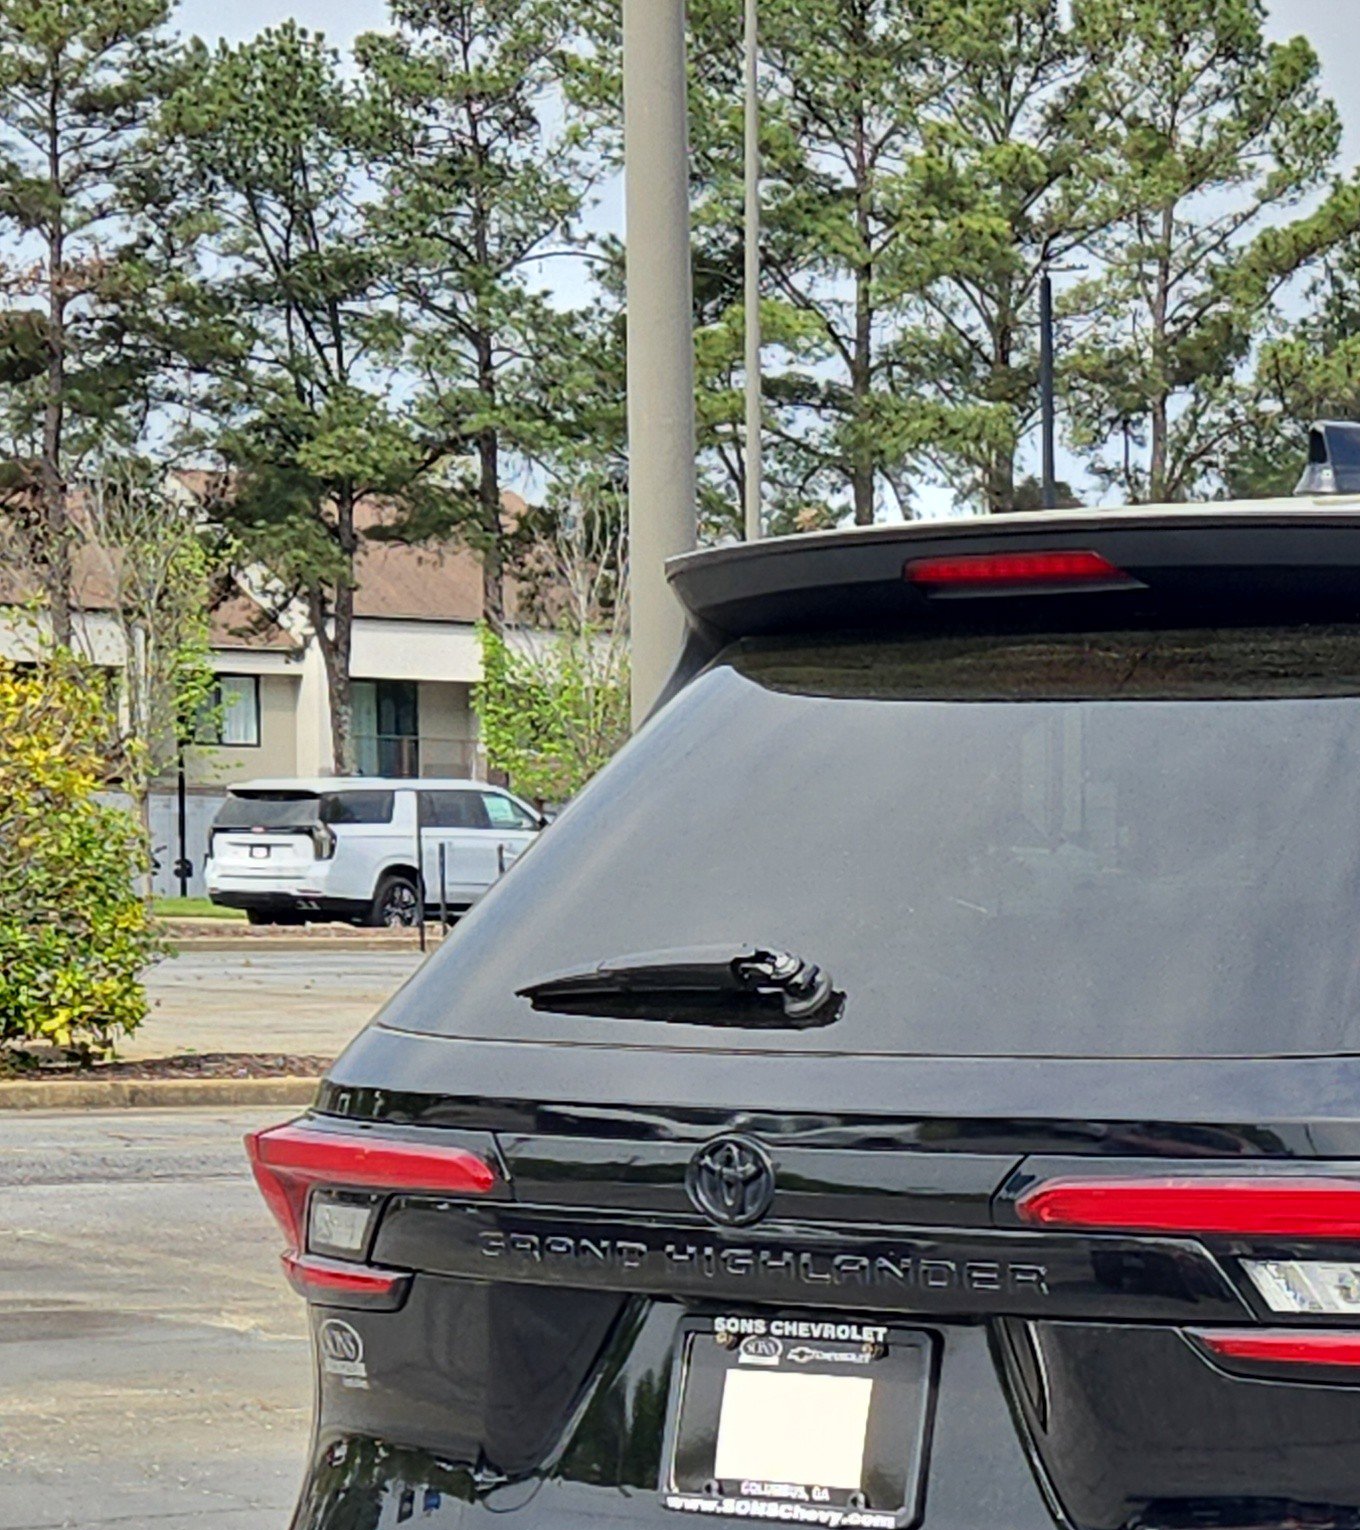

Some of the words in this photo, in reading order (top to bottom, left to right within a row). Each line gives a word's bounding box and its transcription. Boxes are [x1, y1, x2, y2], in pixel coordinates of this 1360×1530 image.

[478, 1231, 648, 1269] GRAND
[664, 1243, 1049, 1296] HIGHLANDER
[714, 1317, 766, 1335] SONS
[770, 1321, 888, 1342] CHEVROLET
